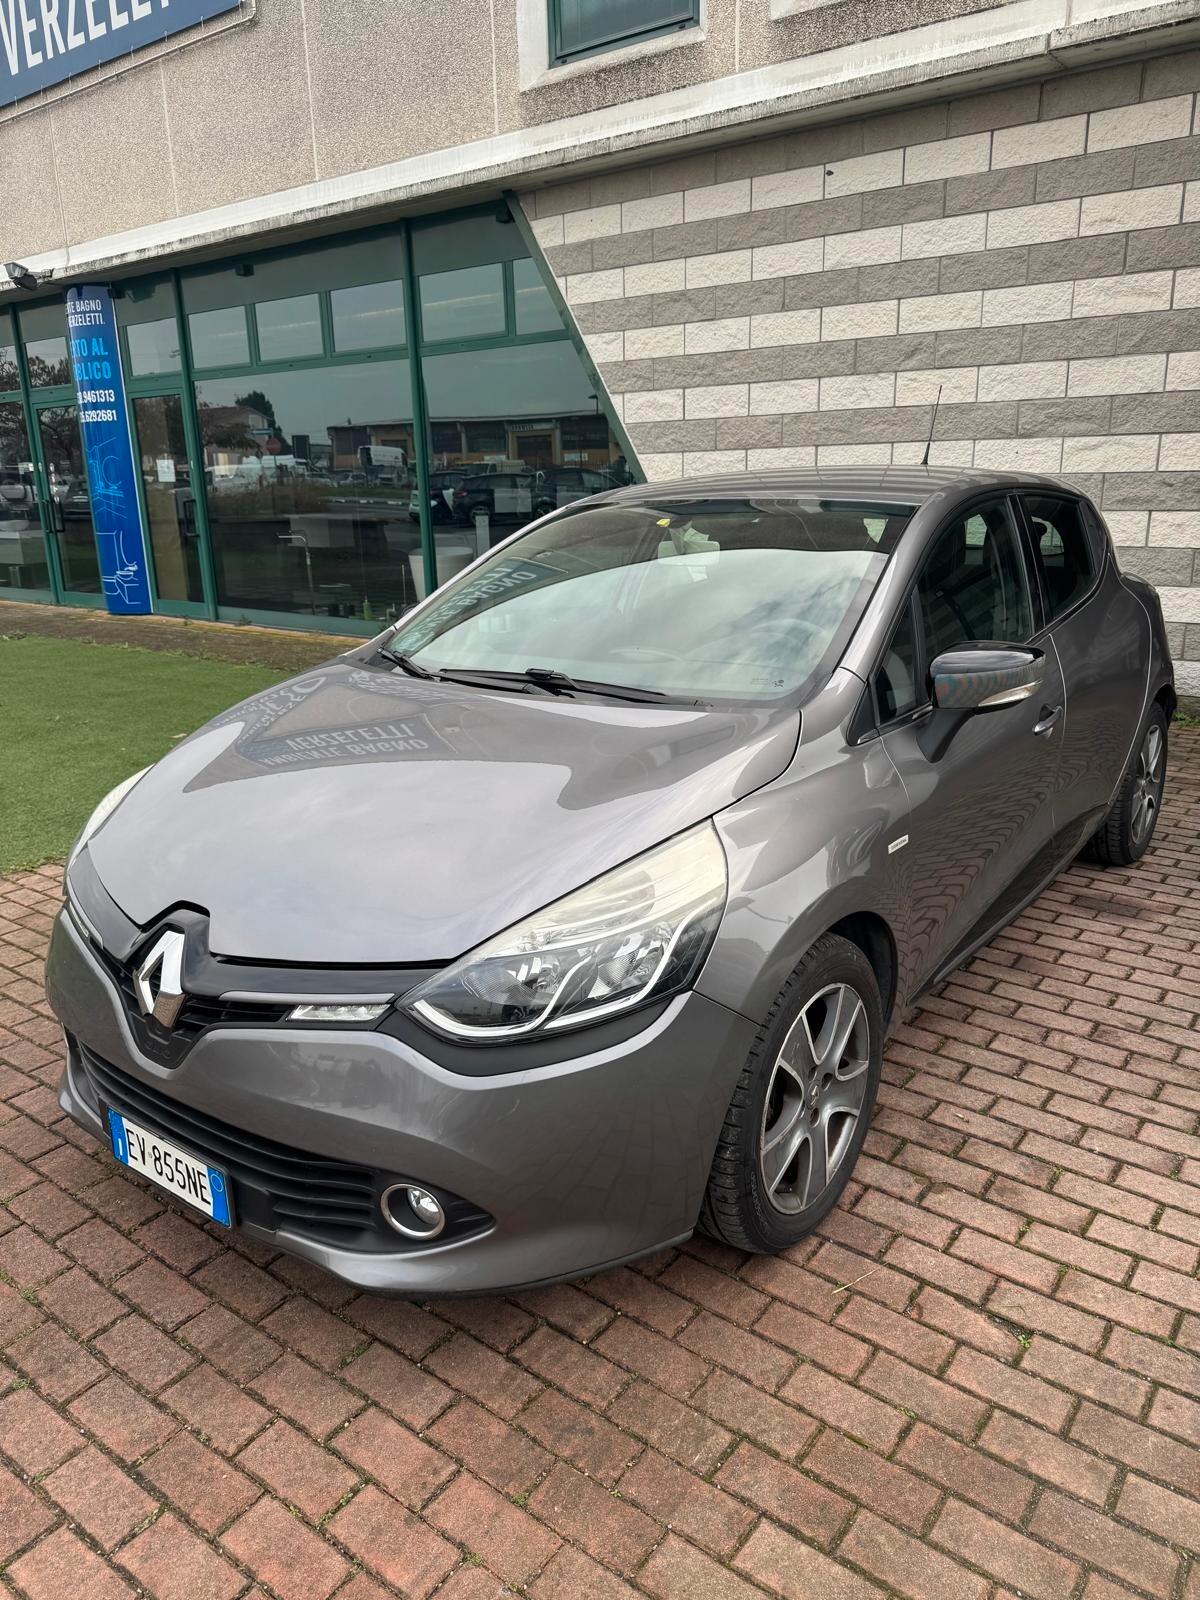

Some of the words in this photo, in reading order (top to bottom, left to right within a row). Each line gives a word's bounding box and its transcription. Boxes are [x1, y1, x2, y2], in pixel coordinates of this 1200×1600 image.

[76, 299, 102, 313] BAGNO
[71, 338, 88, 357] RTO
[92, 337, 108, 356] AL
[75, 361, 112, 381] BLICO
[152, 1144, 212, 1206] 855NE
